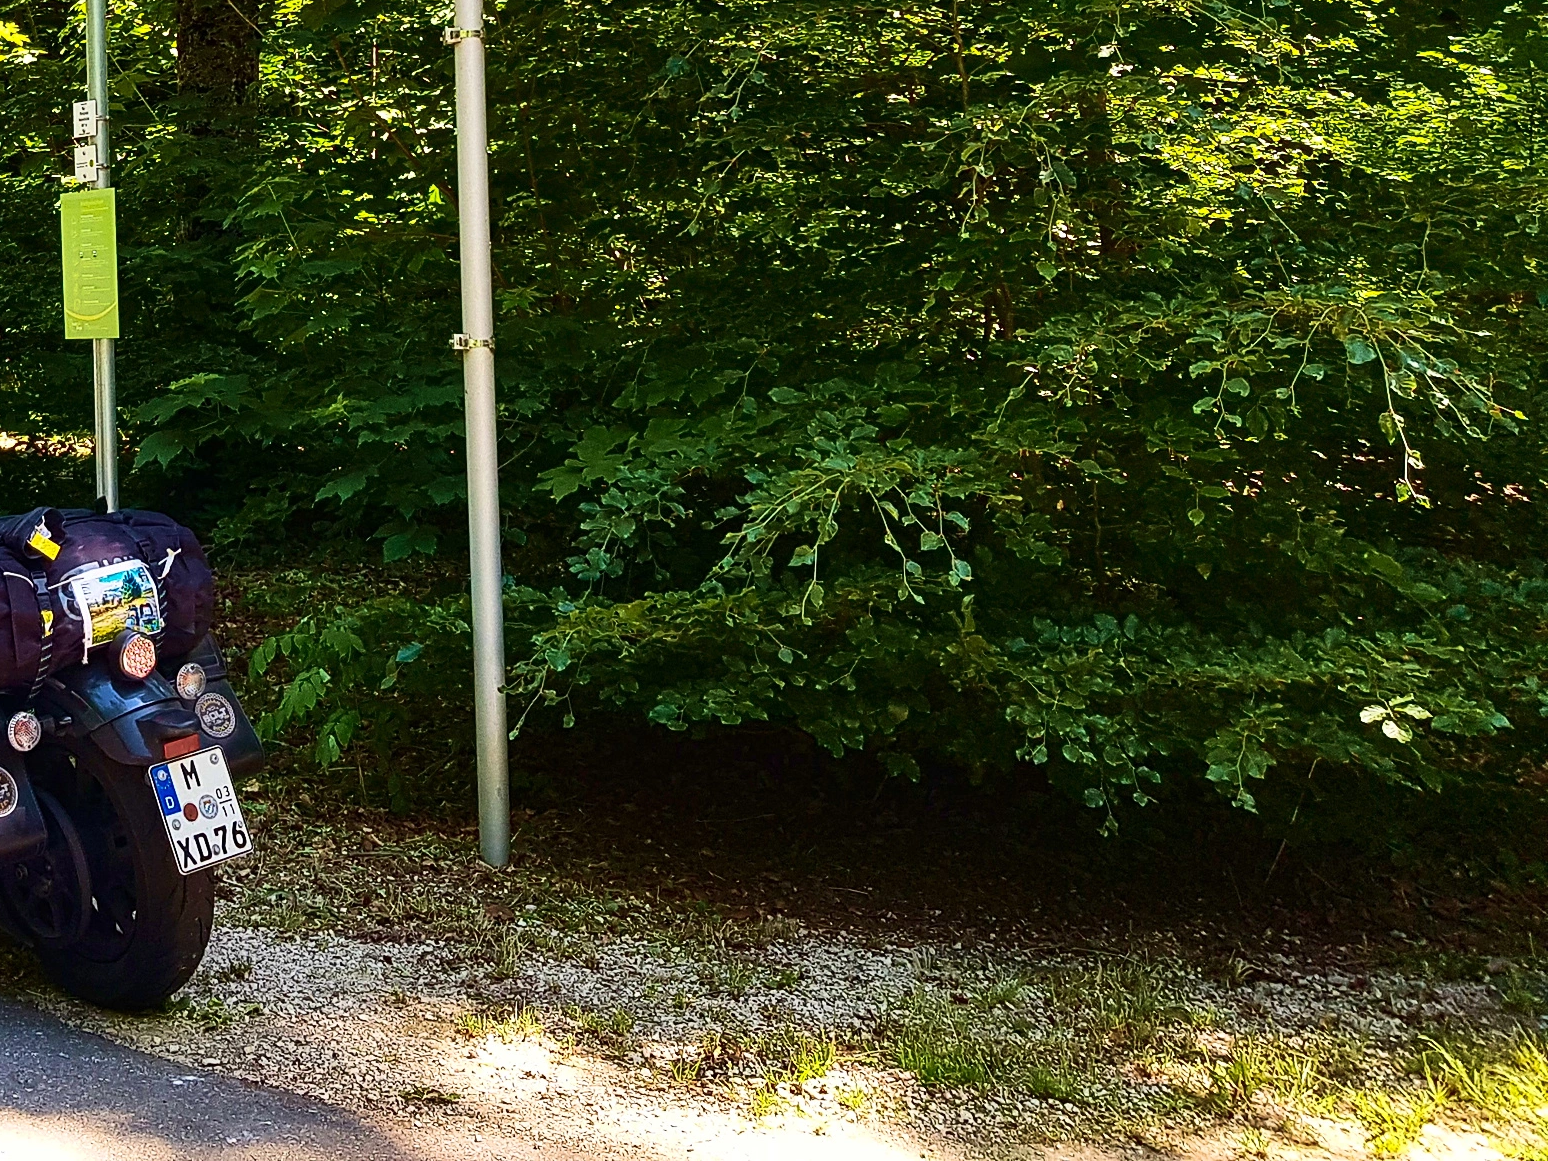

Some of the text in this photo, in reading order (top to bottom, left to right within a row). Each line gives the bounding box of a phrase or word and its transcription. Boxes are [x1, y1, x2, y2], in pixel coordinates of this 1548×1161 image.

[203, 707, 227, 723] BOLT
[180, 760, 201, 790] M
[215, 785, 230, 799] 03
[165, 796, 175, 809] D
[222, 803, 235, 817] 11
[213, 821, 247, 855] 76
